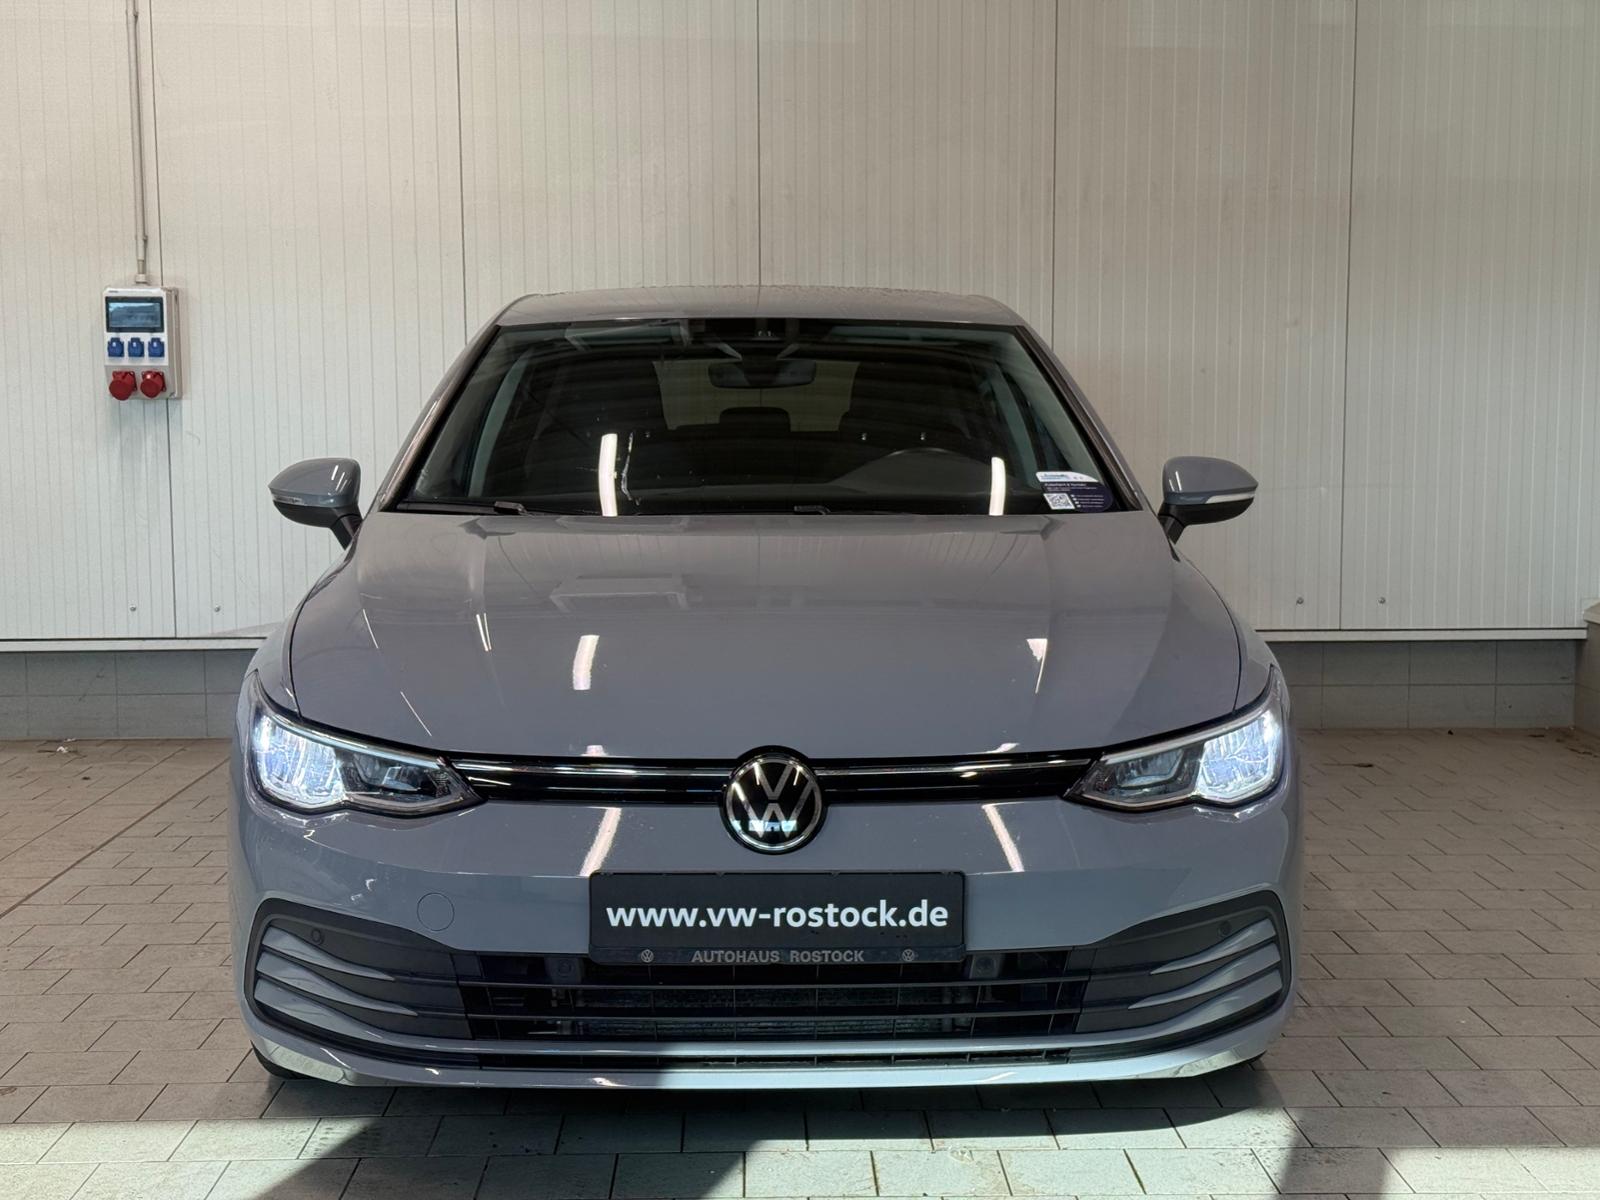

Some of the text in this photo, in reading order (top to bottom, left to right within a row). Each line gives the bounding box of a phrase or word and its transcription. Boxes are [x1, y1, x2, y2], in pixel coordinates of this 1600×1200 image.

[729, 759, 818, 843] VW
[605, 899, 949, 928] www.vw-rostock.de
[691, 950, 865, 963] AUTOHAUS ROSTOCK
